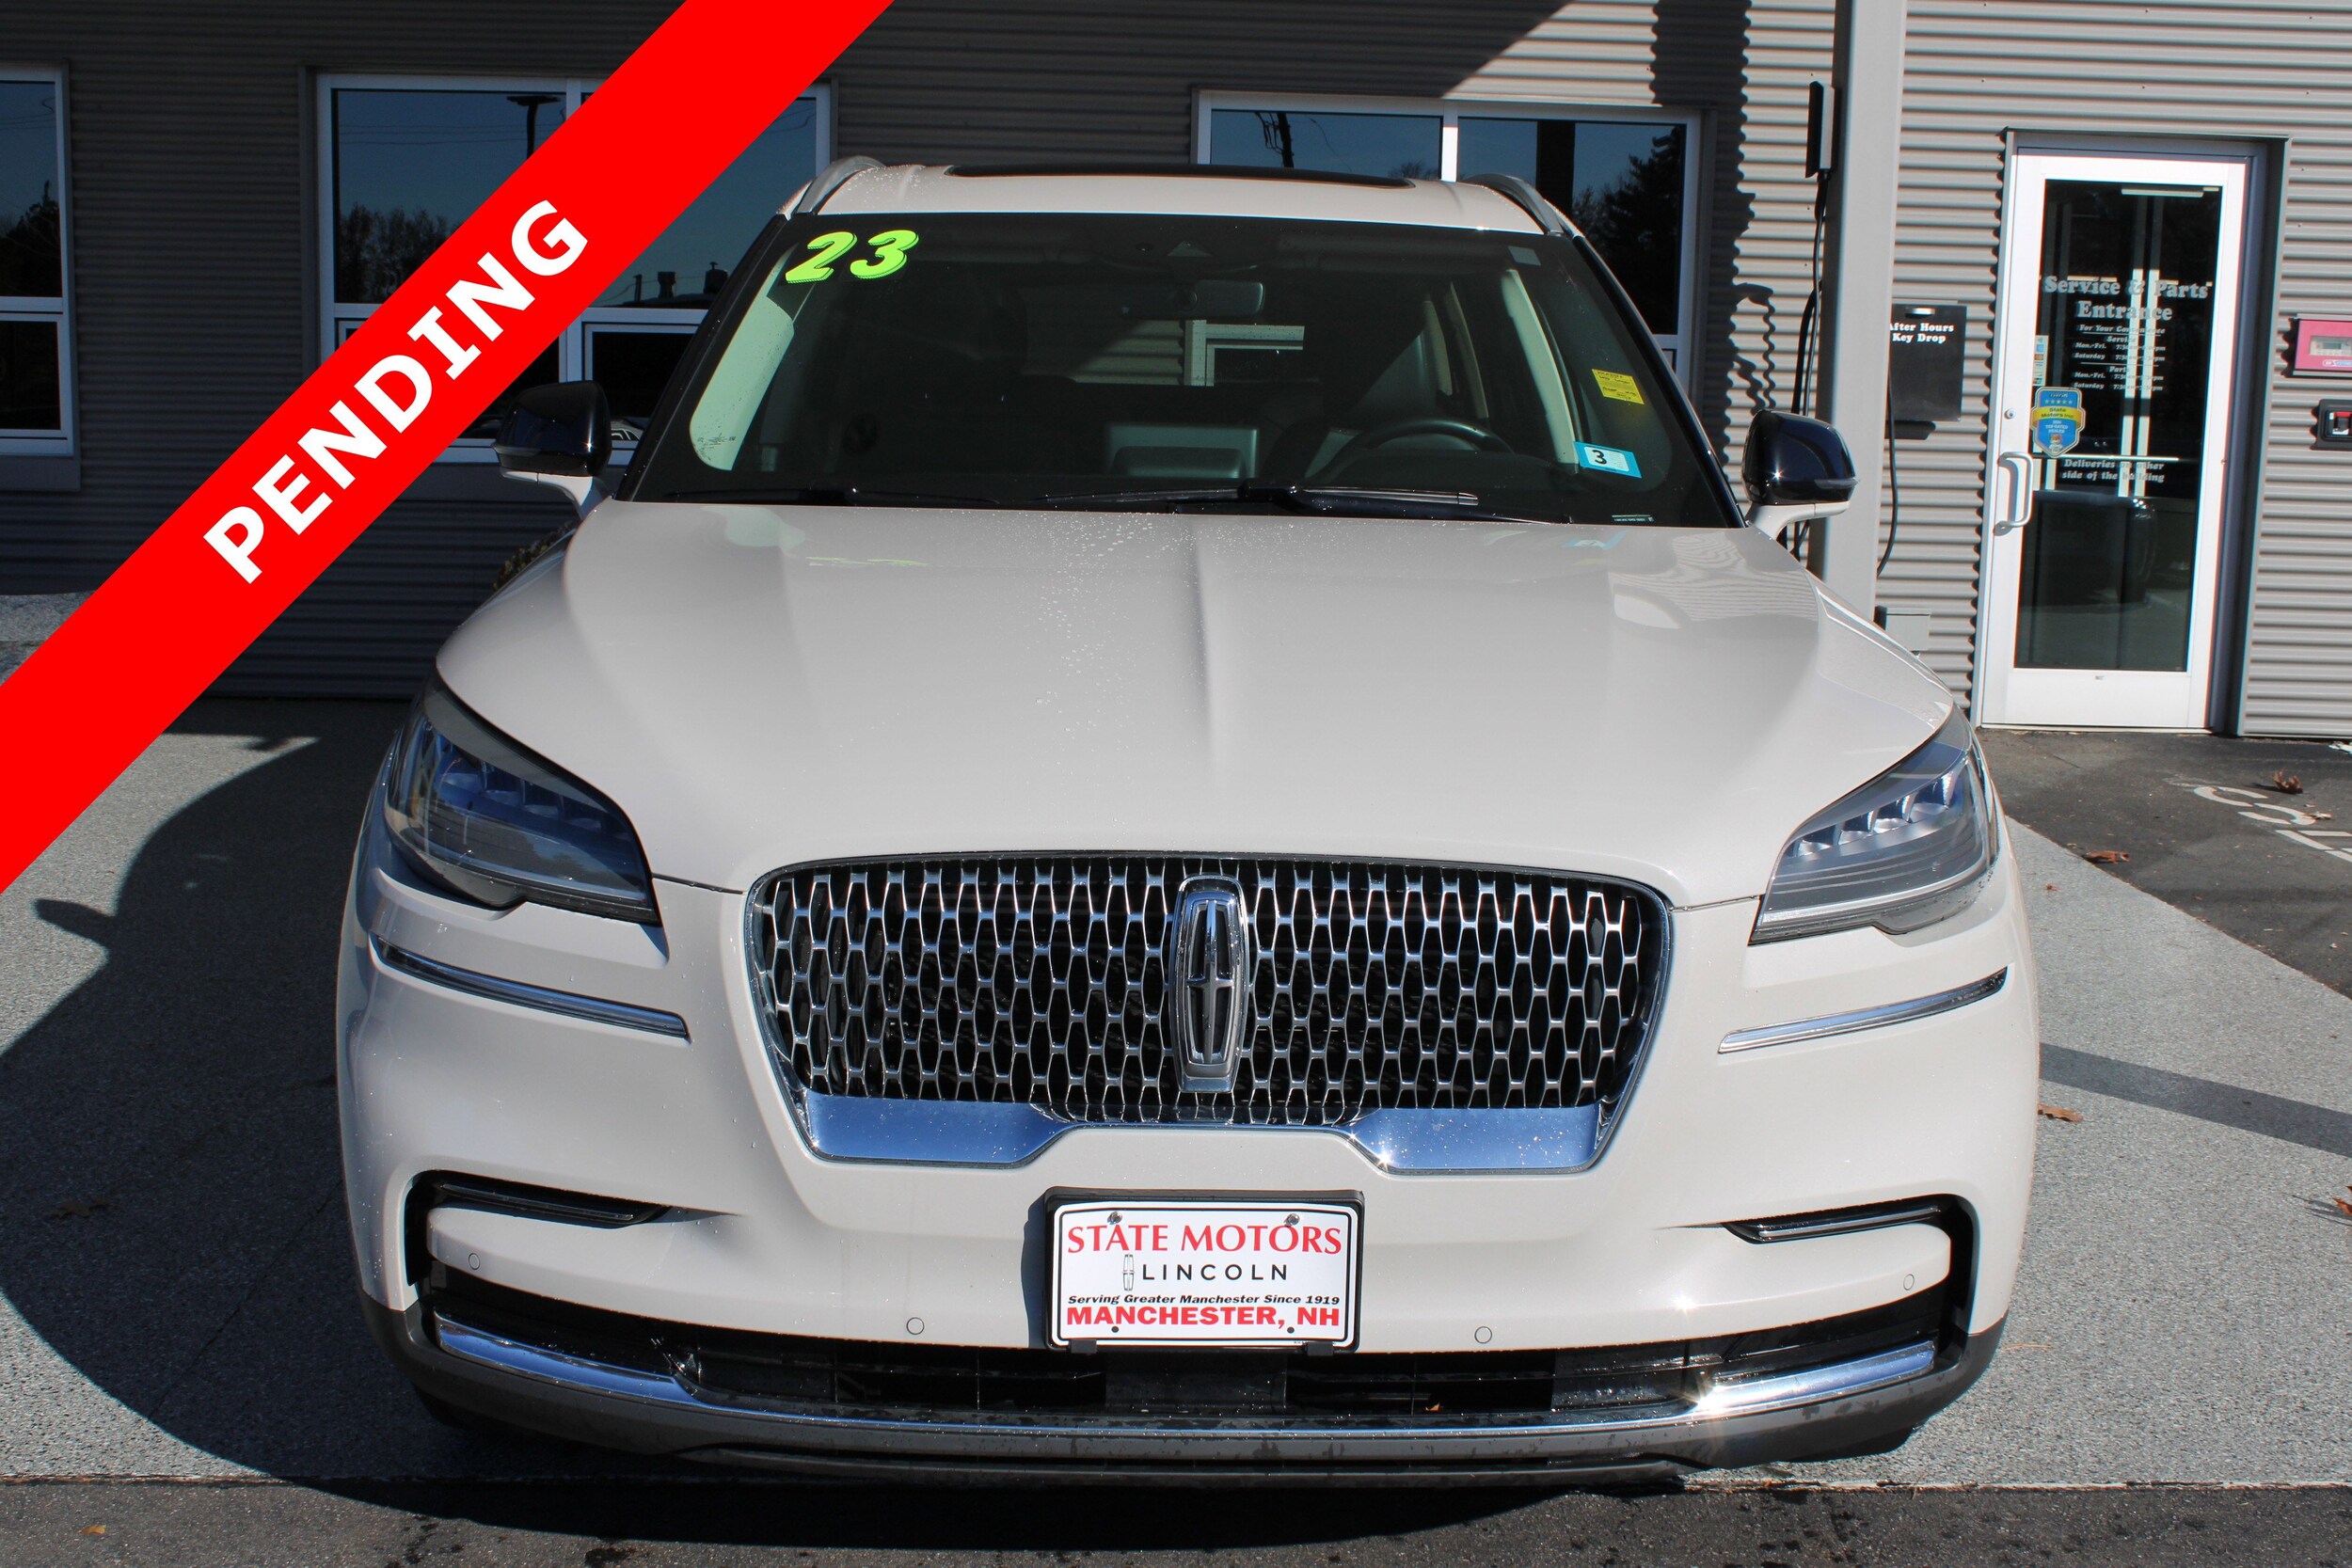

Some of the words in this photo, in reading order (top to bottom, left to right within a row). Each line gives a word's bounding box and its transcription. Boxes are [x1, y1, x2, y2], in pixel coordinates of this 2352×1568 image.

[785, 230, 920, 284] 23
[2042, 276, 2121, 295] Service
[2127, 279, 2146, 295] &
[2154, 280, 2209, 299] Parts
[2077, 300, 2173, 321] Entrance
[1920, 323, 1955, 332] Hours
[1892, 332, 1915, 343] Key
[1917, 333, 1947, 344] Drop
[2073, 382, 2105, 390] Saturday
[1592, 450, 1608, 465] 3
[2063, 459, 2116, 467] Deliveries
[2062, 470, 2083, 479] side
[2086, 471, 2099, 481] of
[2101, 471, 2119, 480] the
[1068, 1224, 1168, 1254] STATE
[1181, 1224, 1343, 1256] MOTORS
[1142, 1263, 1287, 1281] LINCOLN
[1068, 1294, 1120, 1306] Serving
[1123, 1294, 1175, 1305] Greater
[1179, 1294, 1260, 1305] Manchester
[1263, 1294, 1302, 1305] Since
[1305, 1295, 1341, 1306] 1919
[1067, 1306, 1286, 1329] MANCHESTER,
[1296, 1307, 1340, 1327] NH
